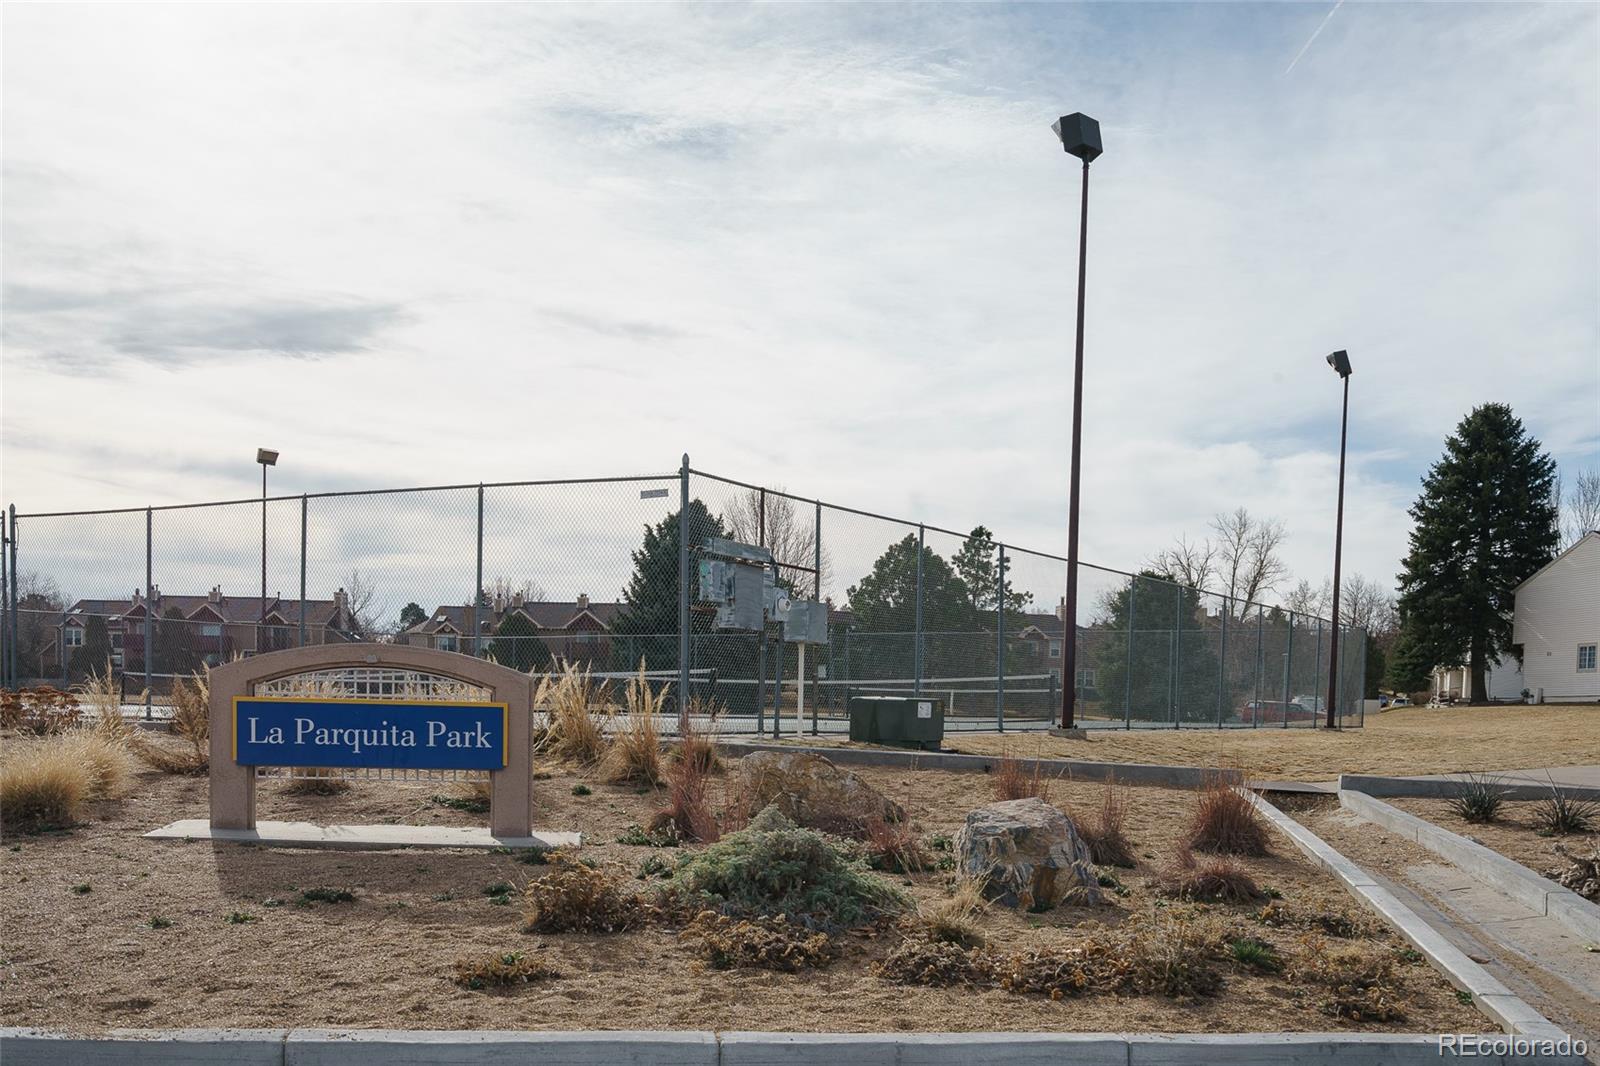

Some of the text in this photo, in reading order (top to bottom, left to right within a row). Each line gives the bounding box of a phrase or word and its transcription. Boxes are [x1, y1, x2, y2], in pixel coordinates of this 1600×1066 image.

[248, 717, 492, 753] La Parquita Park
